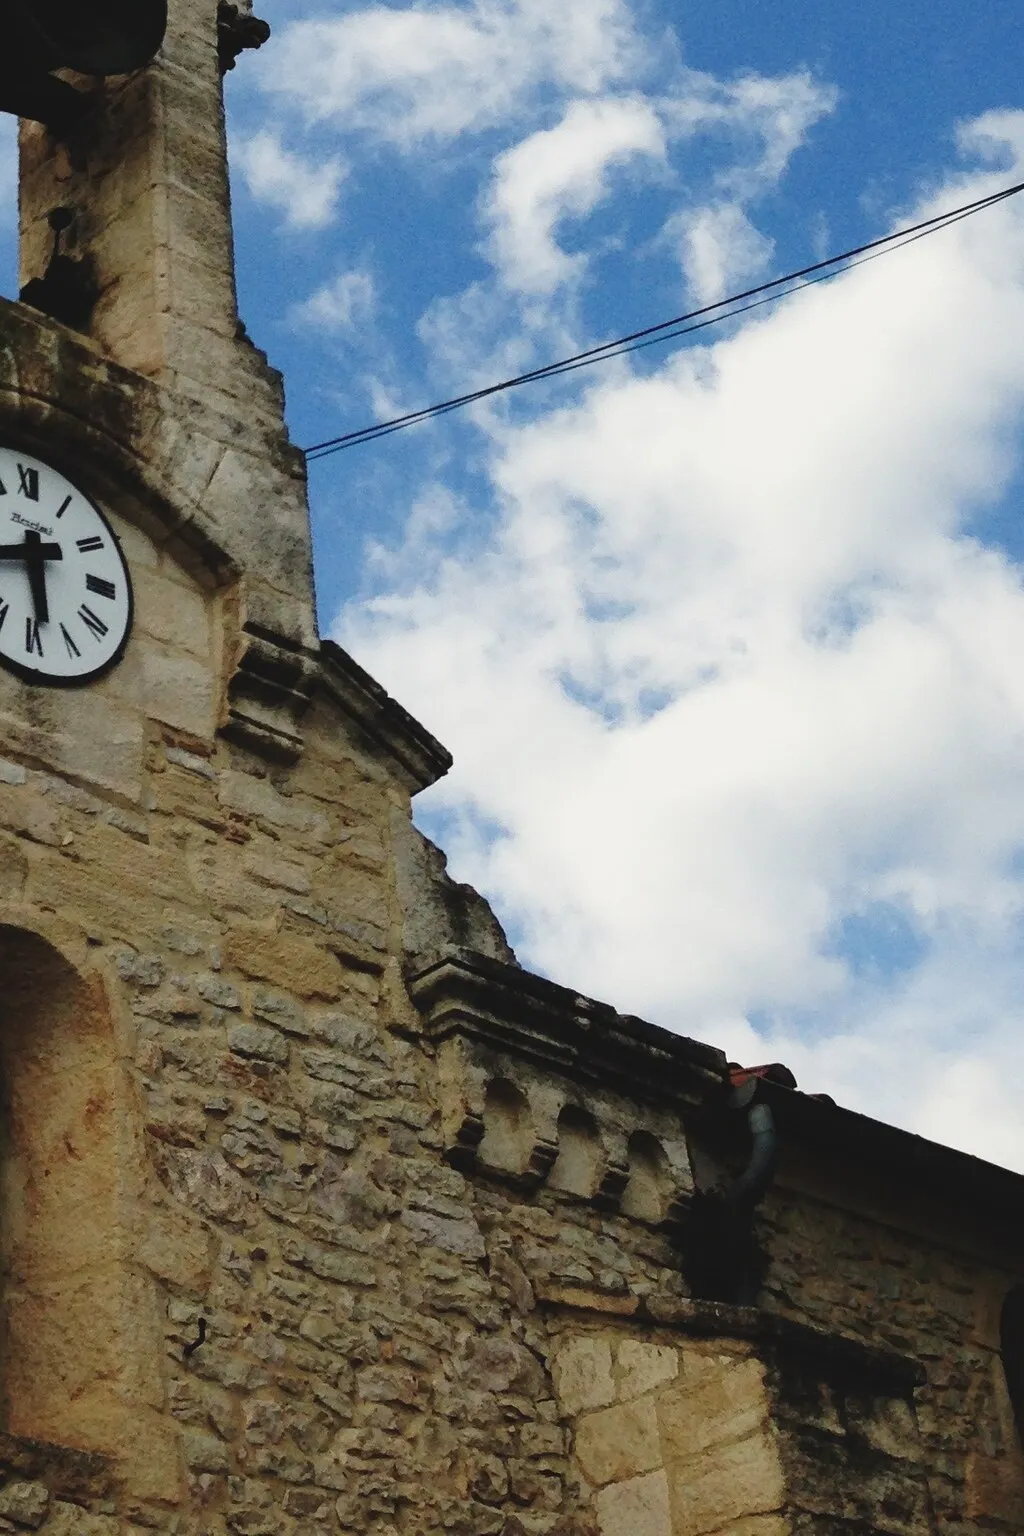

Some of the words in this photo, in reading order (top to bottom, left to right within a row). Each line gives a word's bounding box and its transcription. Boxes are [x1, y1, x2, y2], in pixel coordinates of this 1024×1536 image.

[17, 463, 39, 503] XII
[56, 495, 73, 519] I
[76, 535, 104, 553] II
[85, 573, 116, 601] III
[59, 622, 81, 659] V
